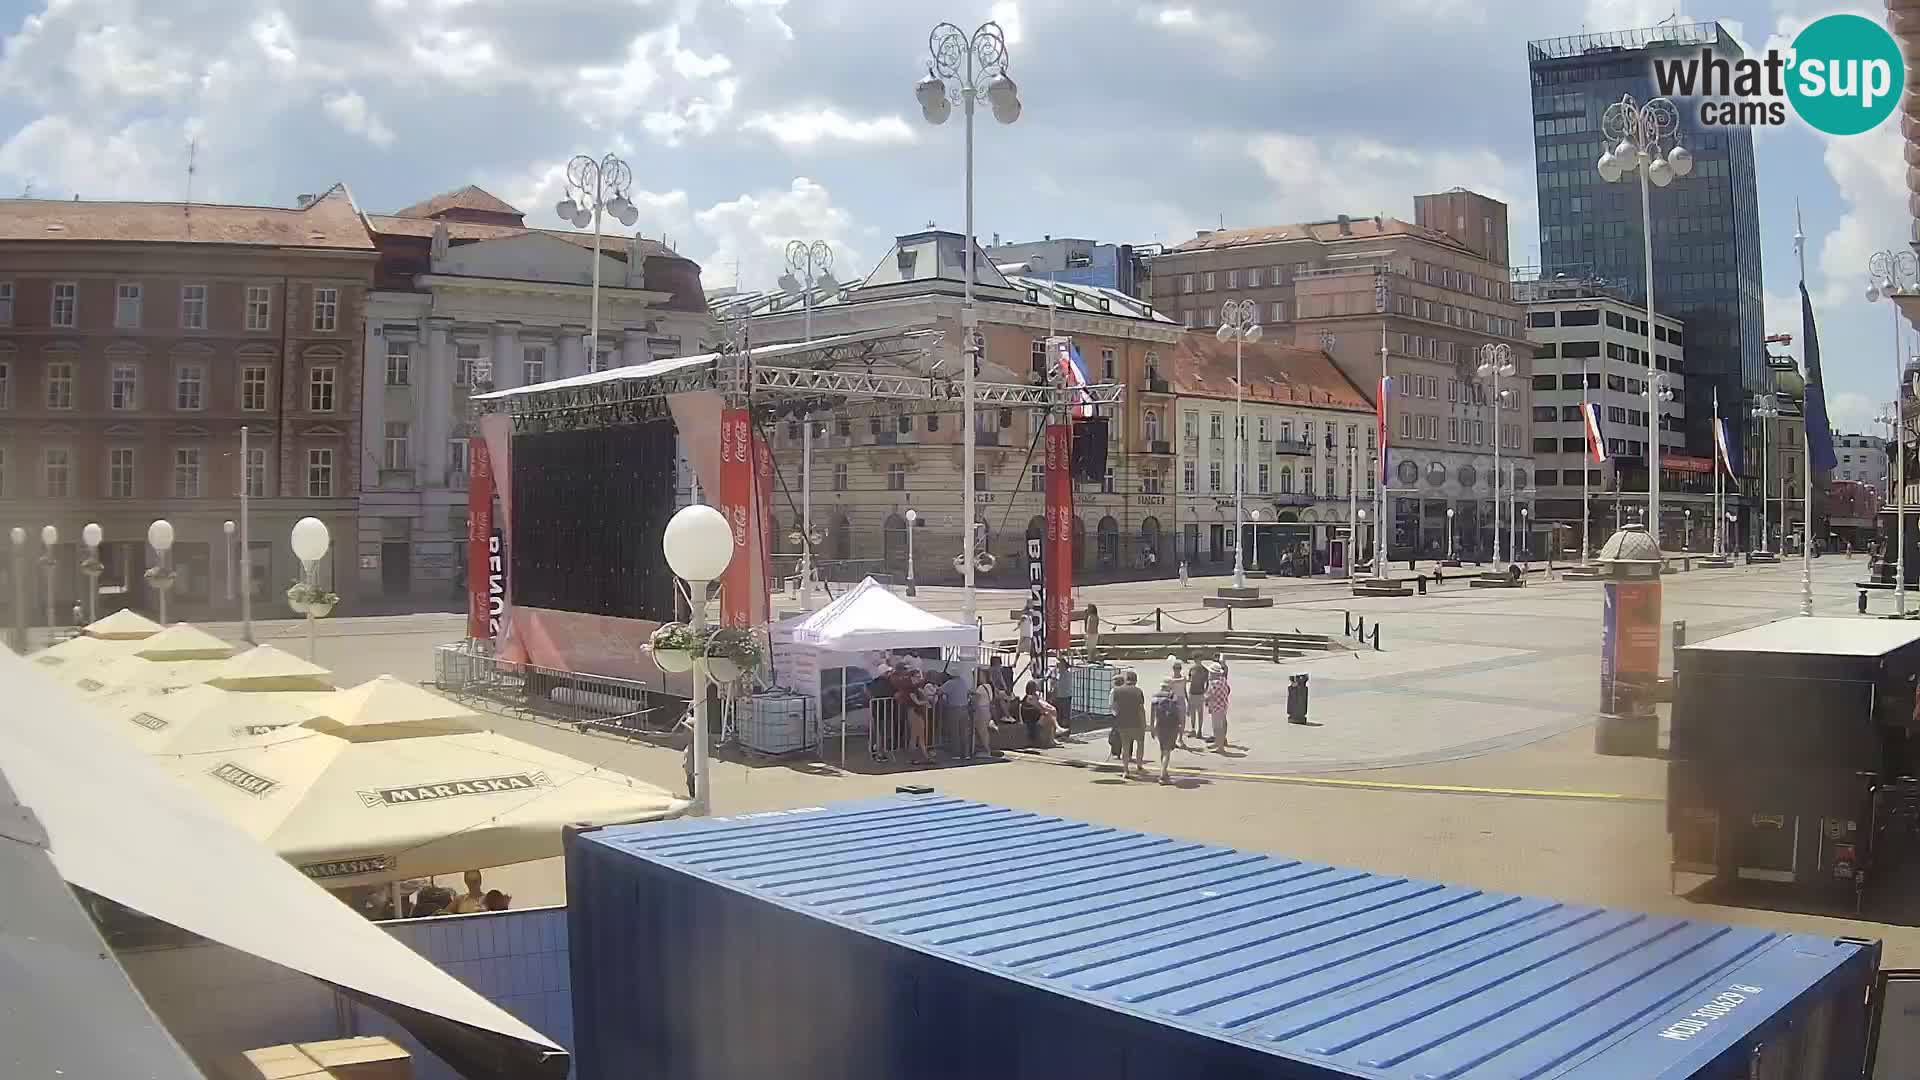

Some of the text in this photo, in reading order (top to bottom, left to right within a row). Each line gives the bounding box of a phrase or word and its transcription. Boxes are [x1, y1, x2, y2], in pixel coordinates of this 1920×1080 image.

[734, 420, 747, 462] Coca-Cola
[734, 504, 746, 546] Coca-Cola
[390, 776, 530, 803] MARASKA
